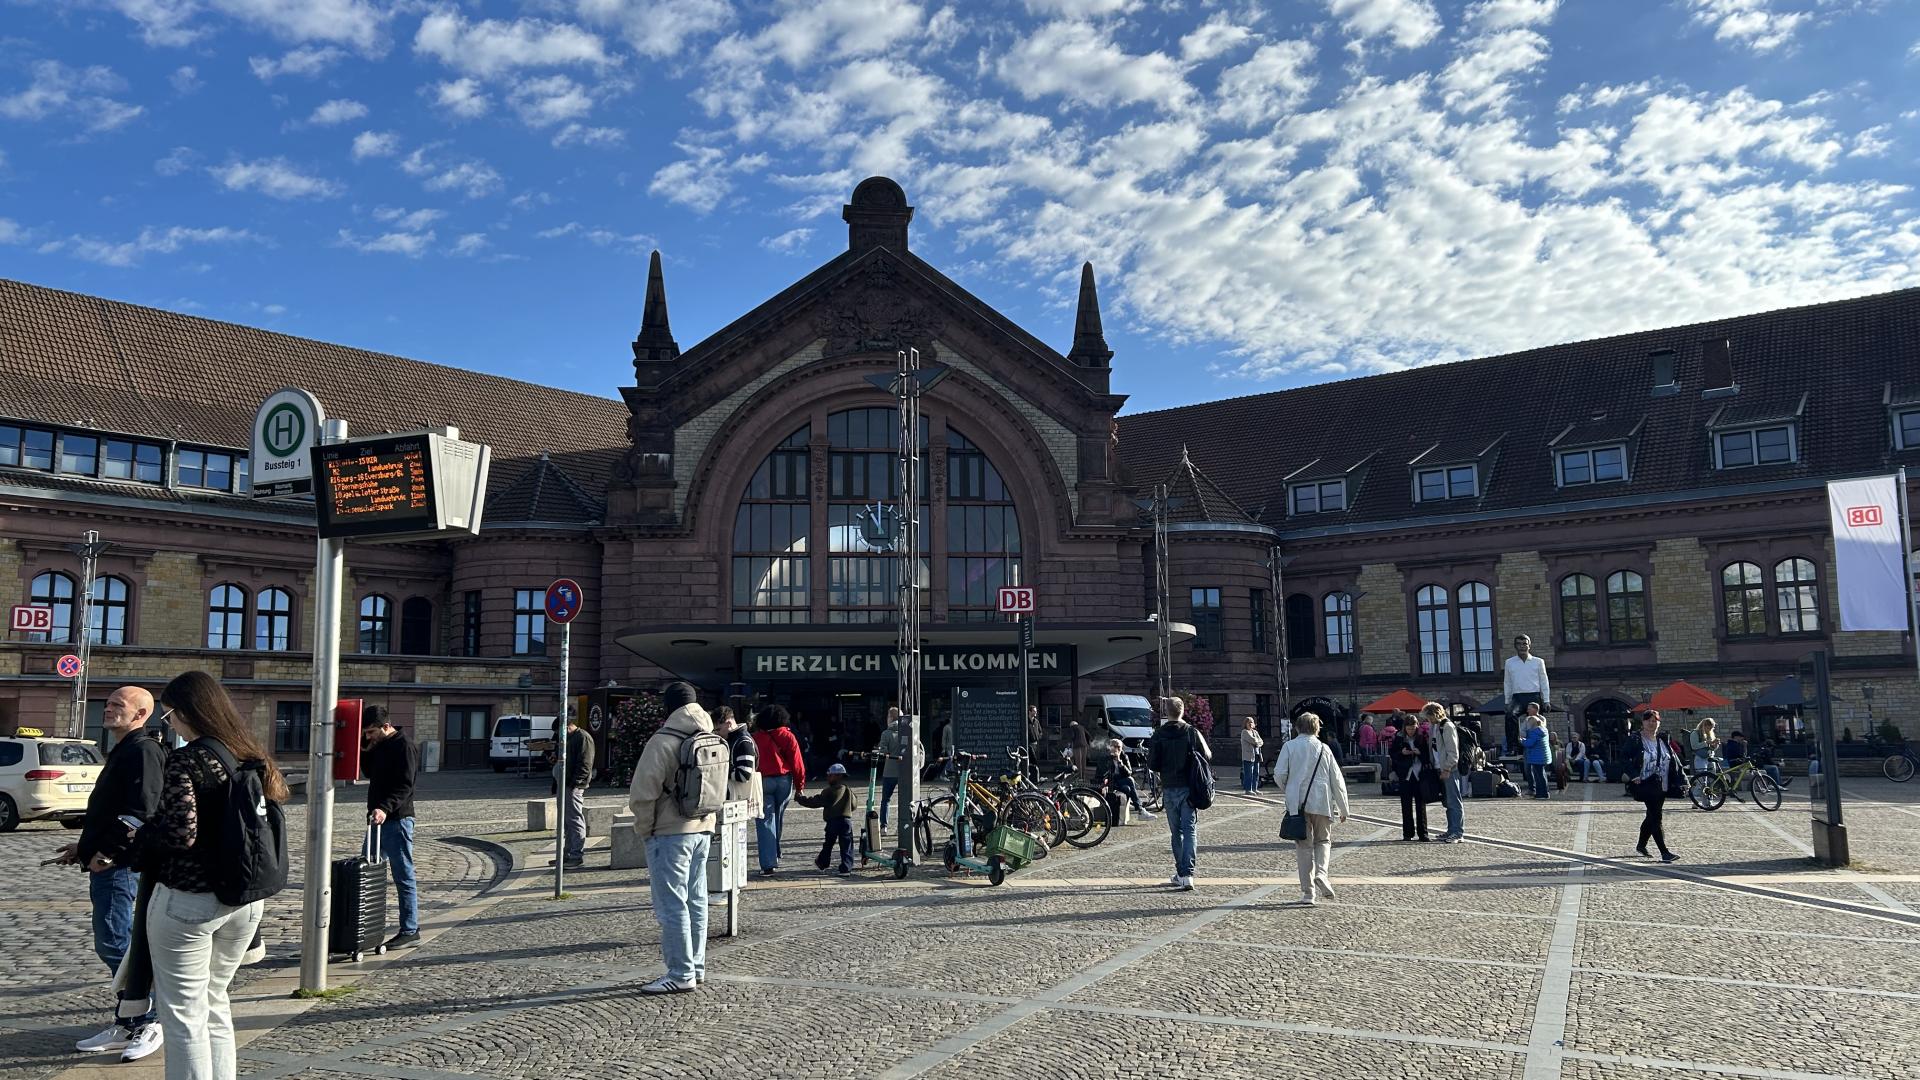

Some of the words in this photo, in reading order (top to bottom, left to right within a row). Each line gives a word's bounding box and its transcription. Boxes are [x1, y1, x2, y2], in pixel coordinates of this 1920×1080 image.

[275, 414, 292, 445] H
[360, 447, 373, 456] Ziel
[395, 442, 420, 452] Abfahrt
[264, 460, 295, 470] Bussteig
[297, 458, 301, 467] 1
[1002, 590, 1032, 609] DB
[16, 609, 49, 628] DB
[757, 654, 881, 672] HERZLICH
[890, 652, 1057, 671] WLLKOMMEN
